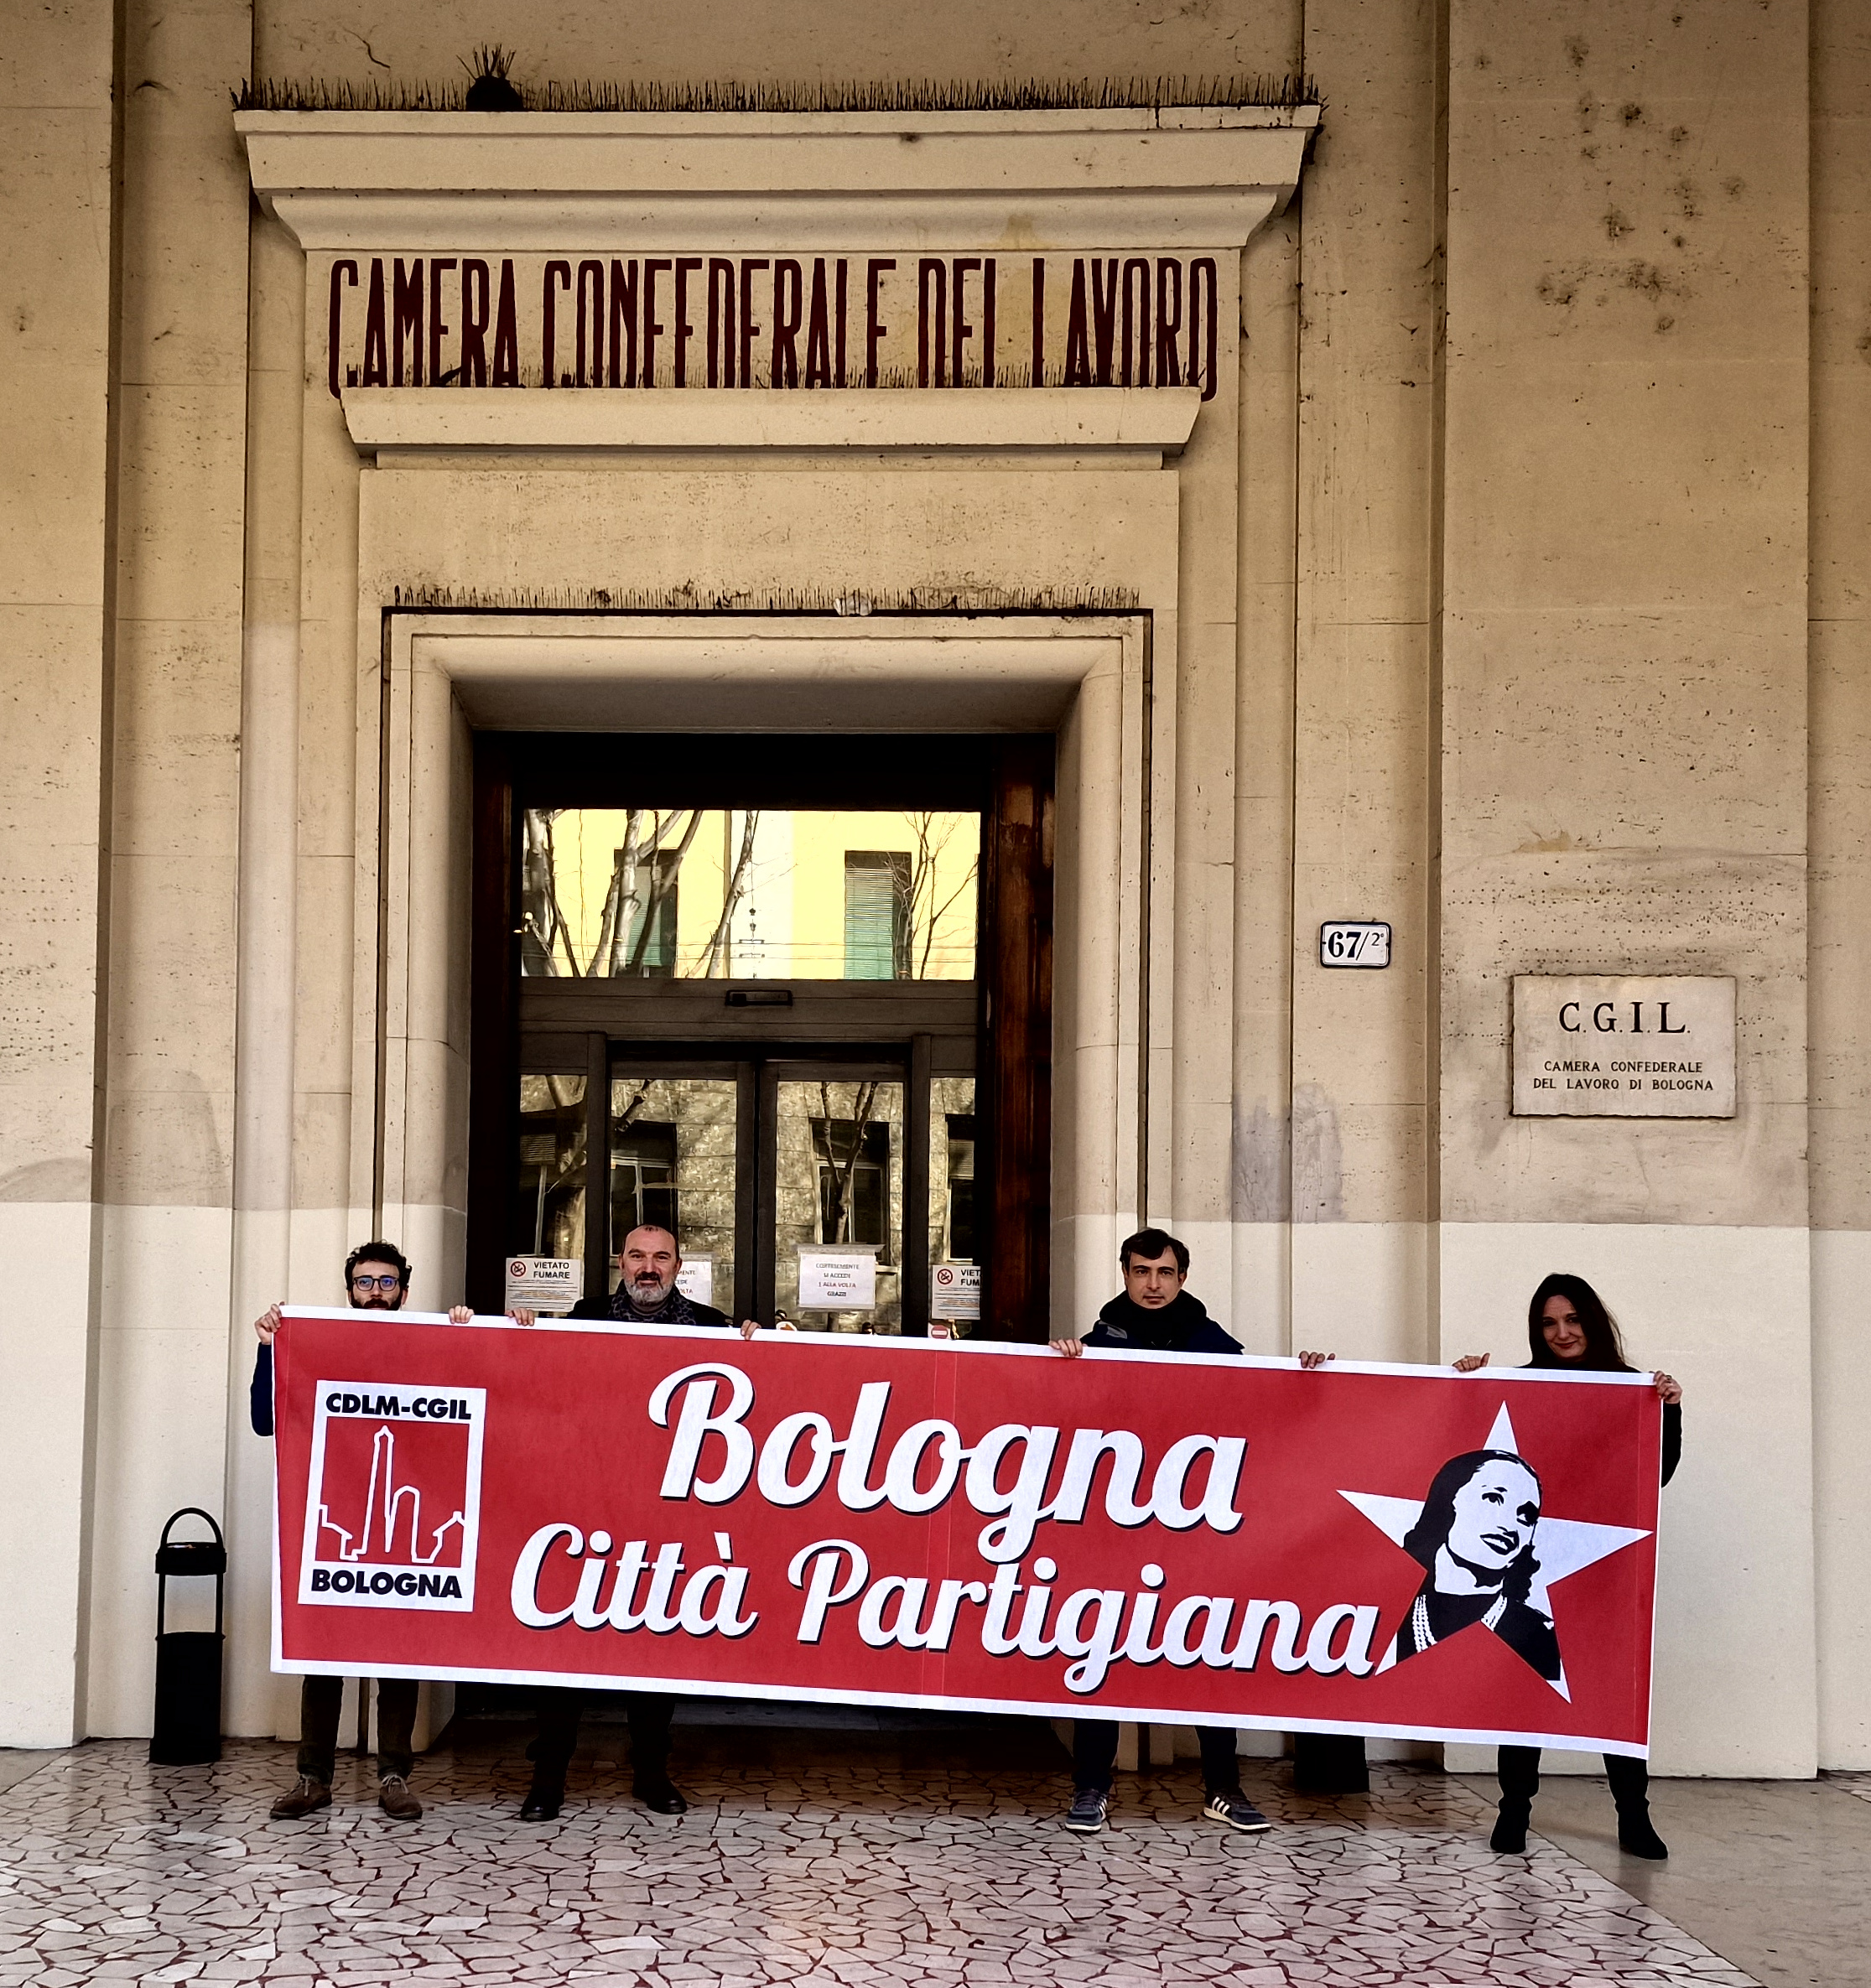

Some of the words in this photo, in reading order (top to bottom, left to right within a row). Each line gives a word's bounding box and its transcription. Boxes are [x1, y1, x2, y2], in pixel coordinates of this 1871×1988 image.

[329, 258, 519, 399] CAMERA
[543, 257, 897, 389] CONFEDERALE
[1544, 1061, 1600, 1072] CAMERA
[1610, 1061, 1703, 1073] CONFEDERALE
[1533, 1078, 1557, 1089] DEL
[1567, 1079, 1619, 1090] LAVORO
[1629, 1079, 1642, 1090] DI
[1652, 1079, 1713, 1091] BOLOGNA
[325, 1393, 471, 1420] CDLM-CGIL
[647, 1363, 1248, 1565] Bologna
[311, 1569, 463, 1598] BOLOGNA
[510, 1523, 759, 1638] Città
[787, 1539, 1380, 1695] Partigiana
